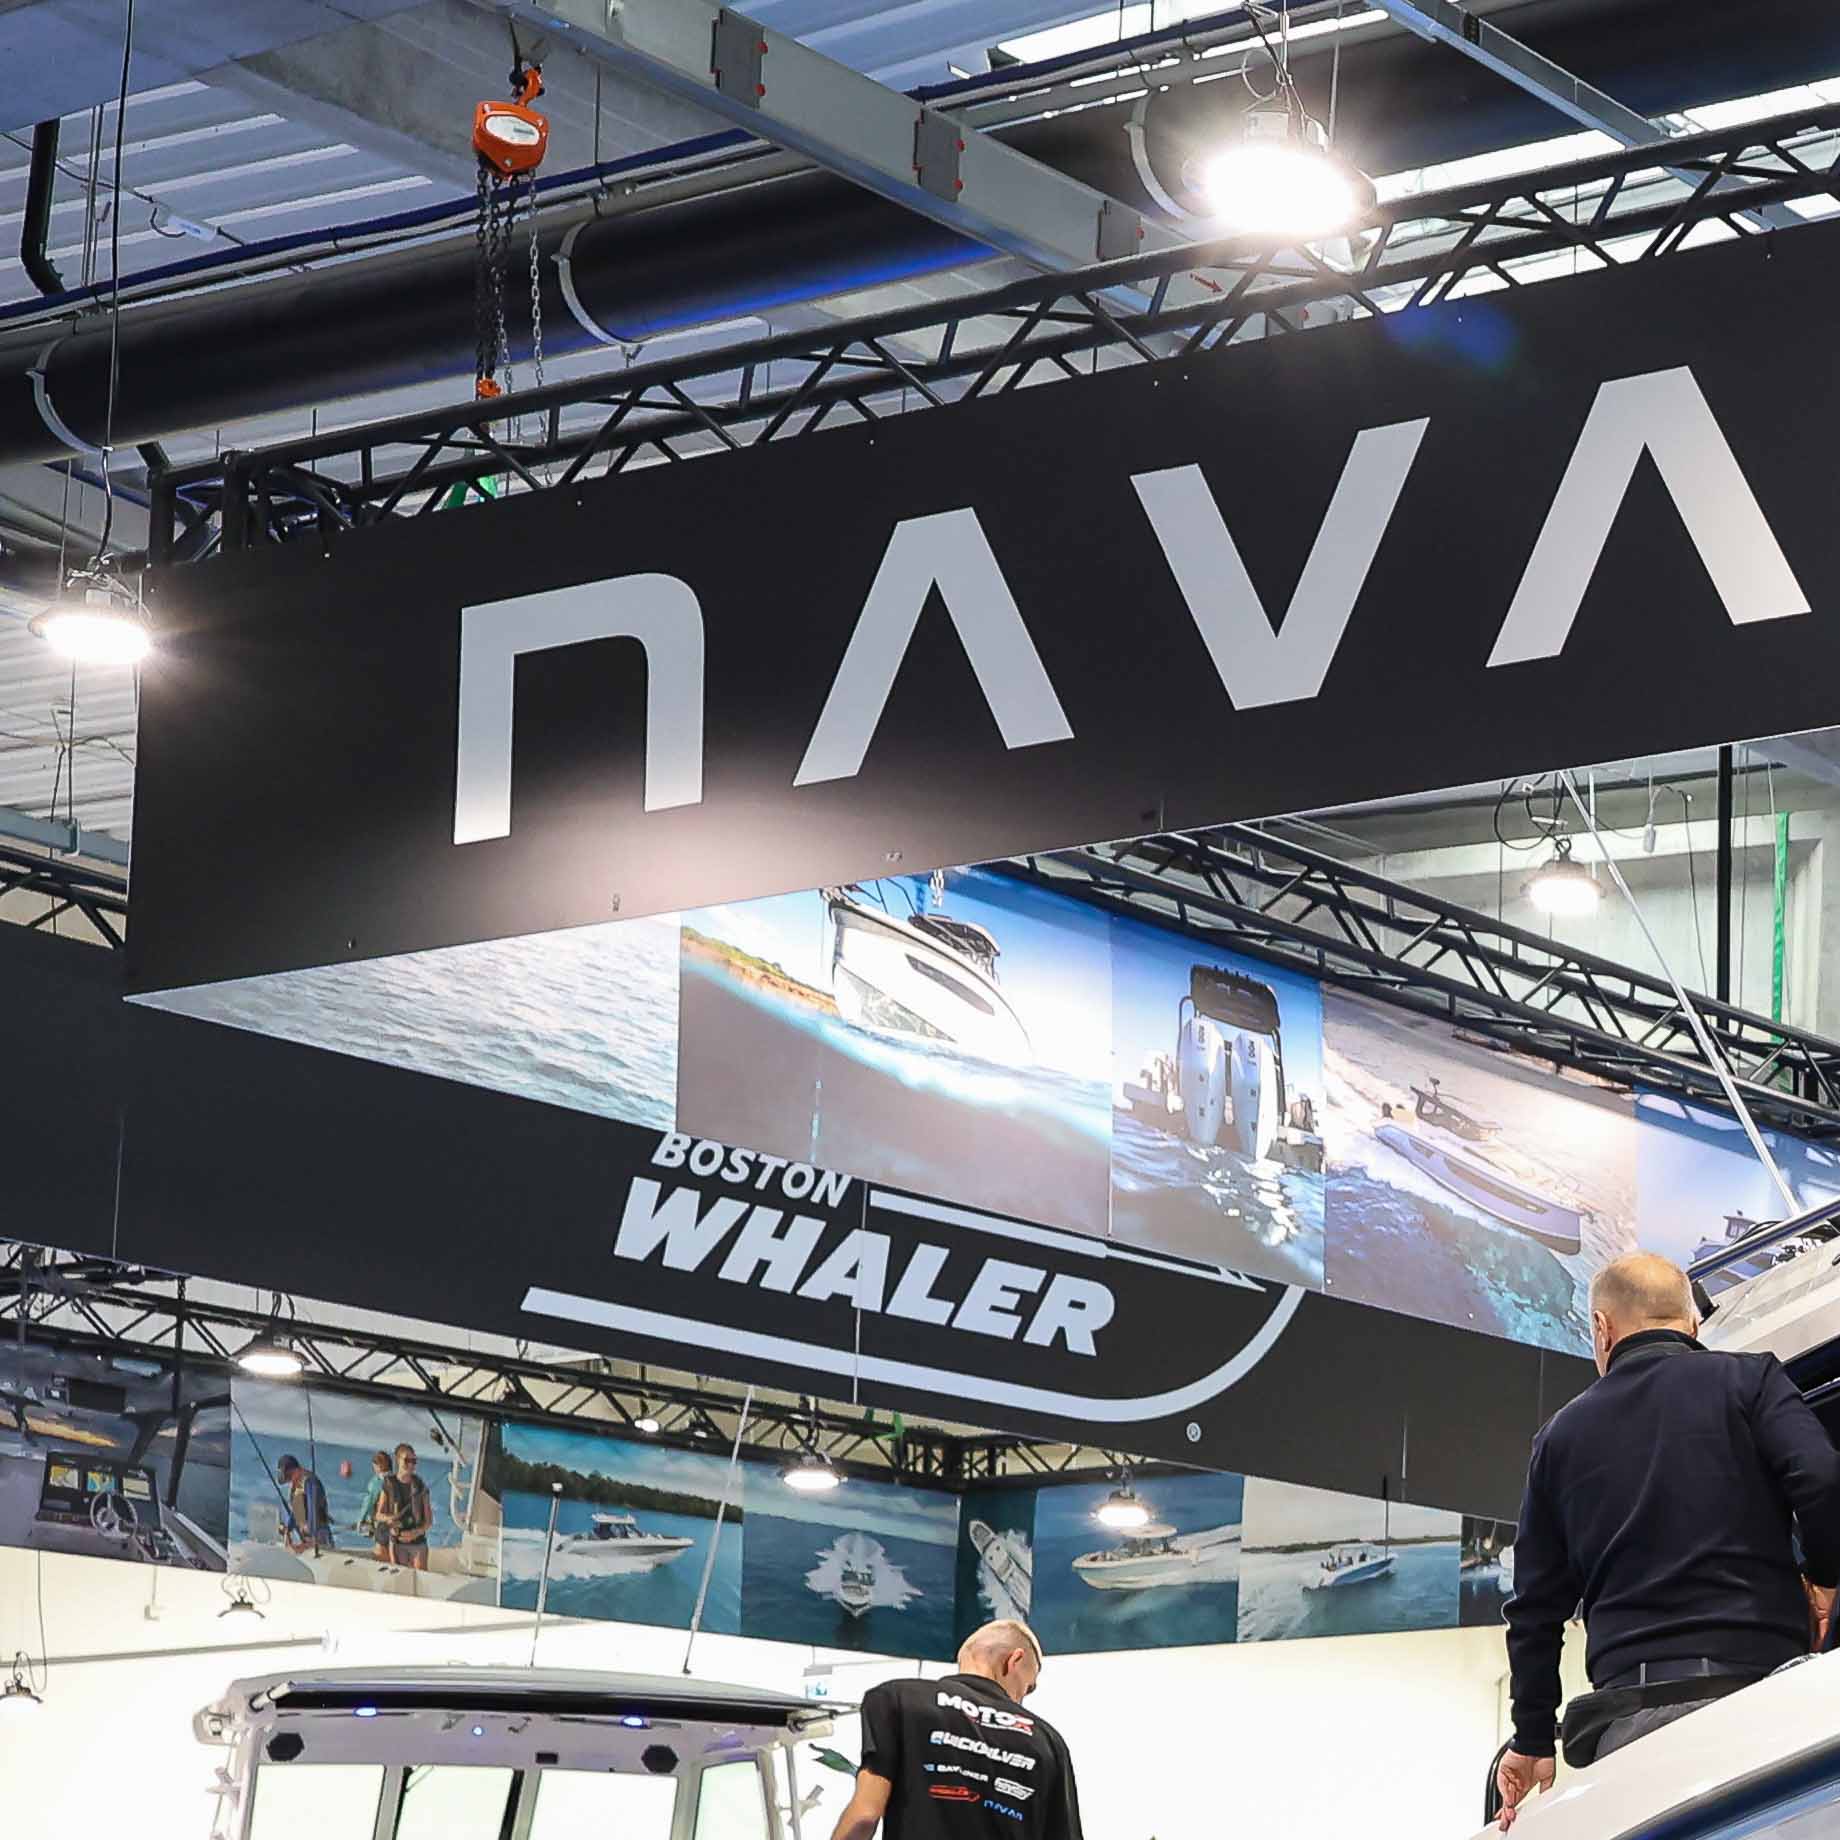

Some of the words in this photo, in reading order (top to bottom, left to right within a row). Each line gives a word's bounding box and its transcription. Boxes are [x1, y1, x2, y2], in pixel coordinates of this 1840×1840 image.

[651, 1130, 851, 1208] BOSTON
[613, 1177, 1116, 1357] WHALER
[930, 1730, 1036, 1771] QUICKSILVER
